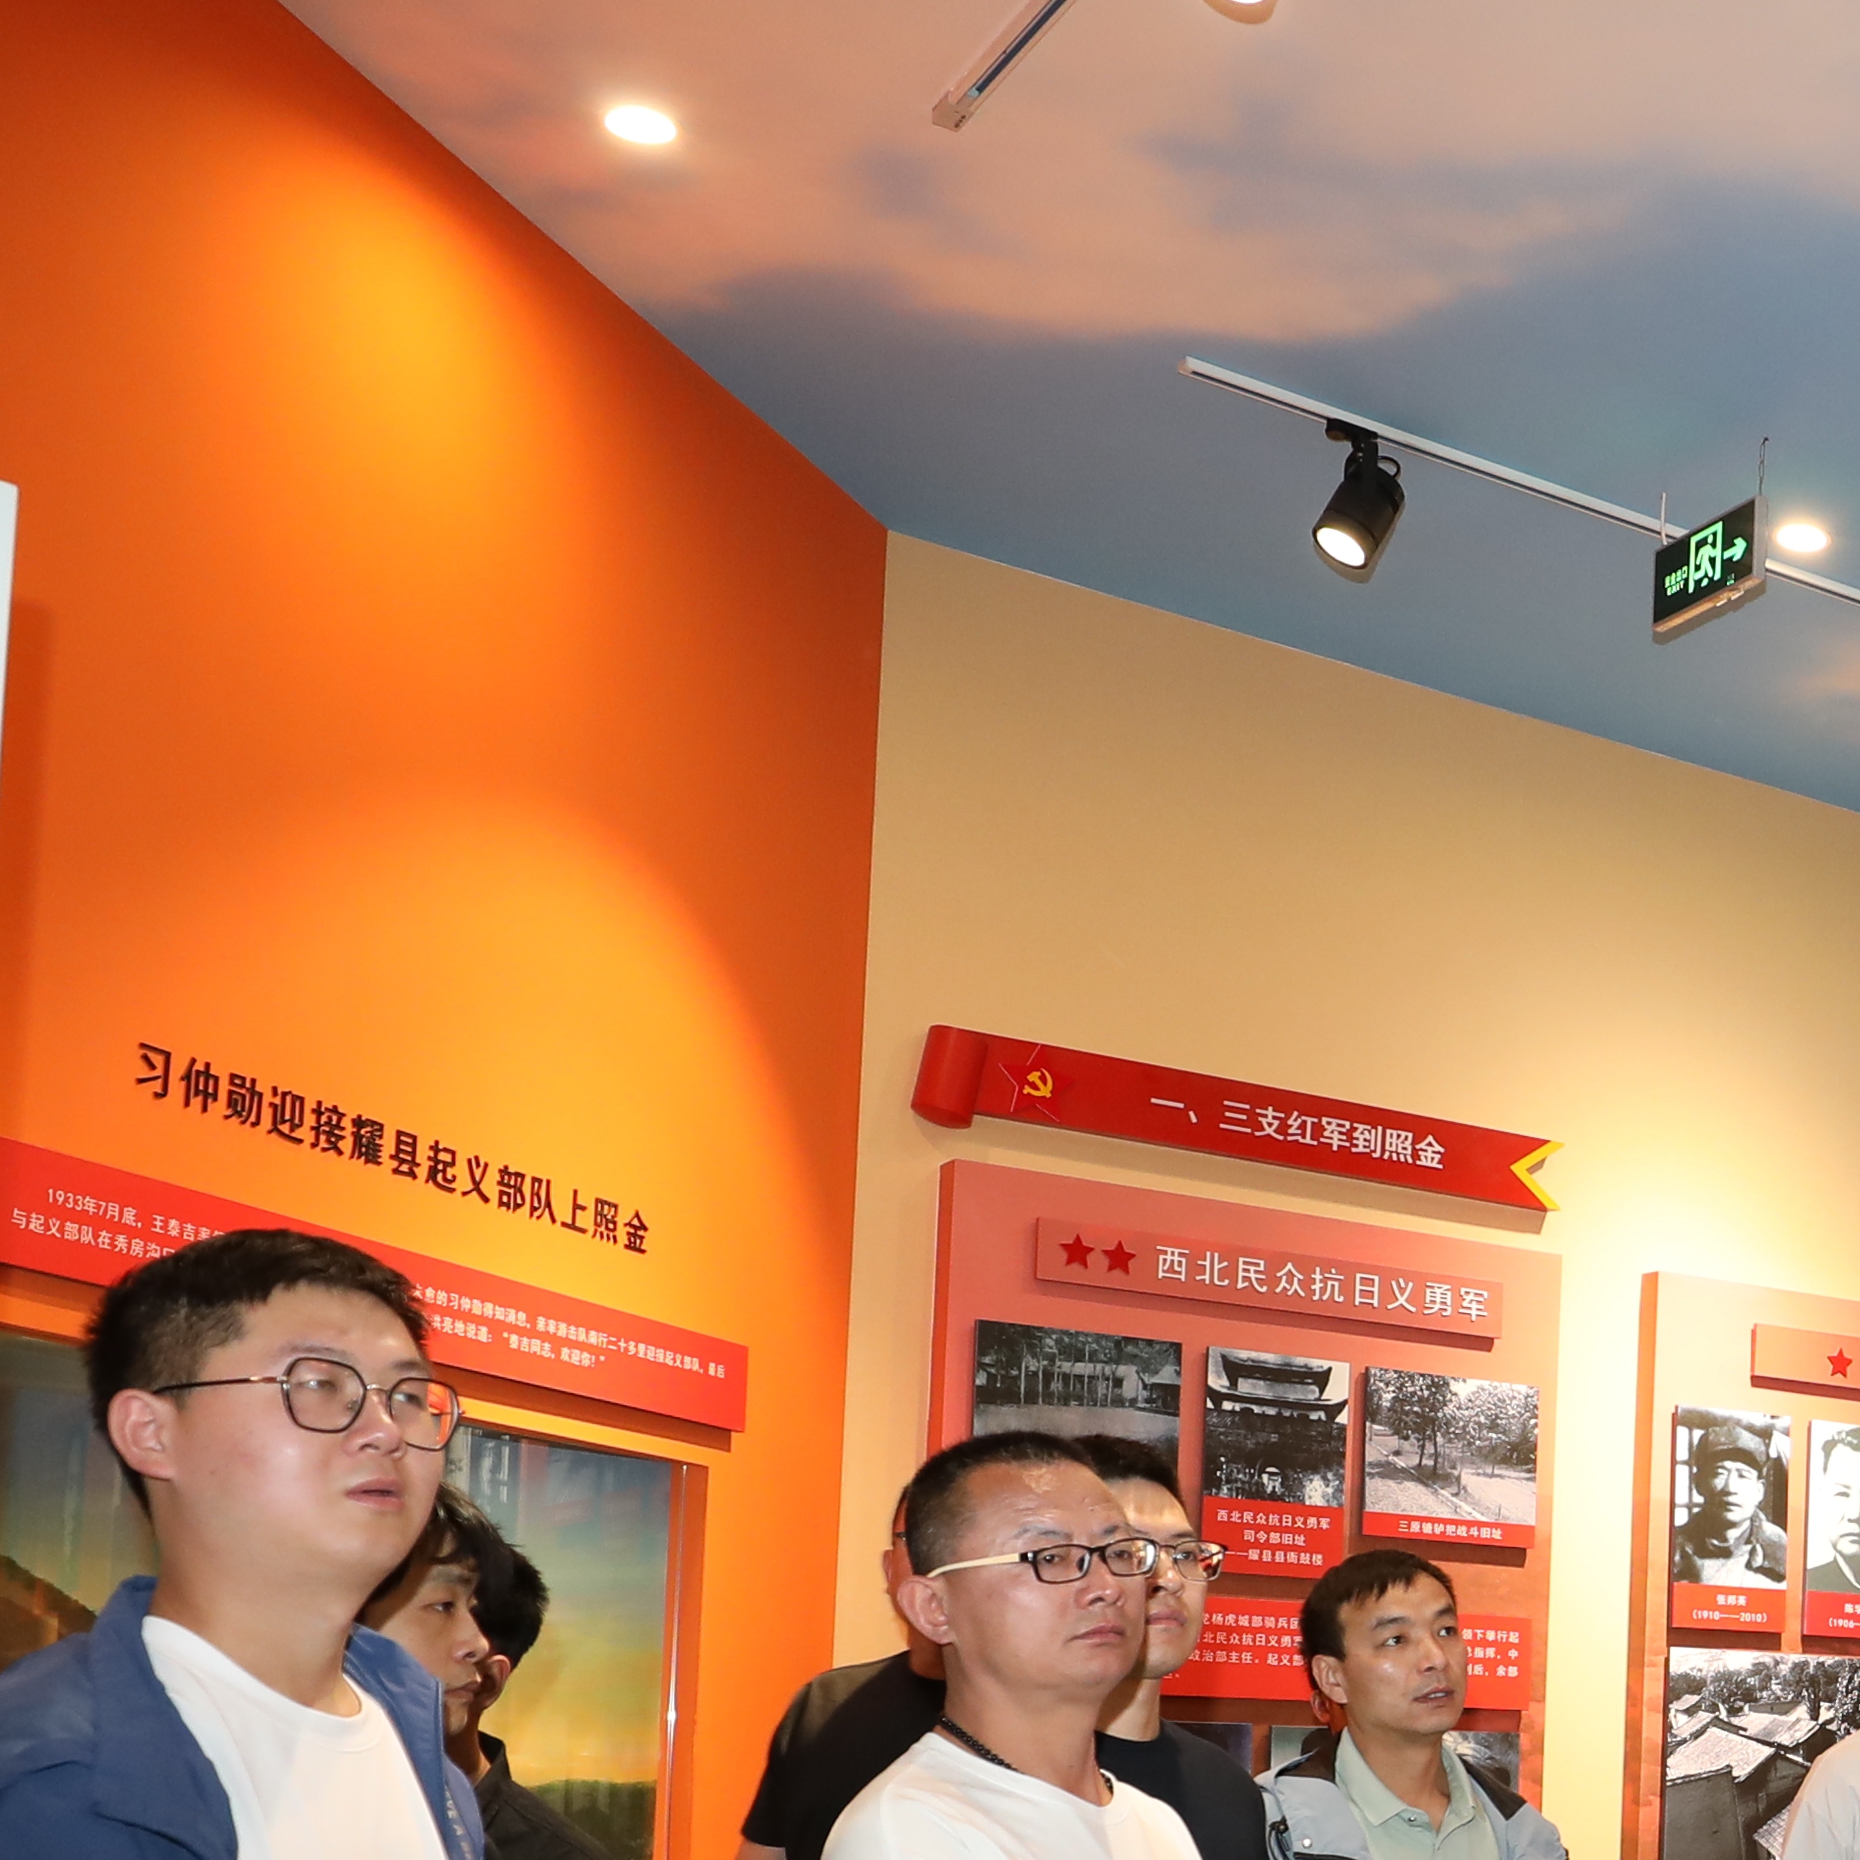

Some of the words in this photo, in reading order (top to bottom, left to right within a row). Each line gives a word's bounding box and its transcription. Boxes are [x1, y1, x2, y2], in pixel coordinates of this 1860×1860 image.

[135, 1041, 649, 1256] 习仲勋迎接耀县起义部队上照金
[1150, 1096, 1446, 1170] 一、三支红军到照金
[1155, 1244, 1490, 1322] 西北民众抗日义勇军
[1216, 1508, 1331, 1530] 西北民众抗日义勇军
[1243, 1529, 1306, 1547] 司令部旧址
